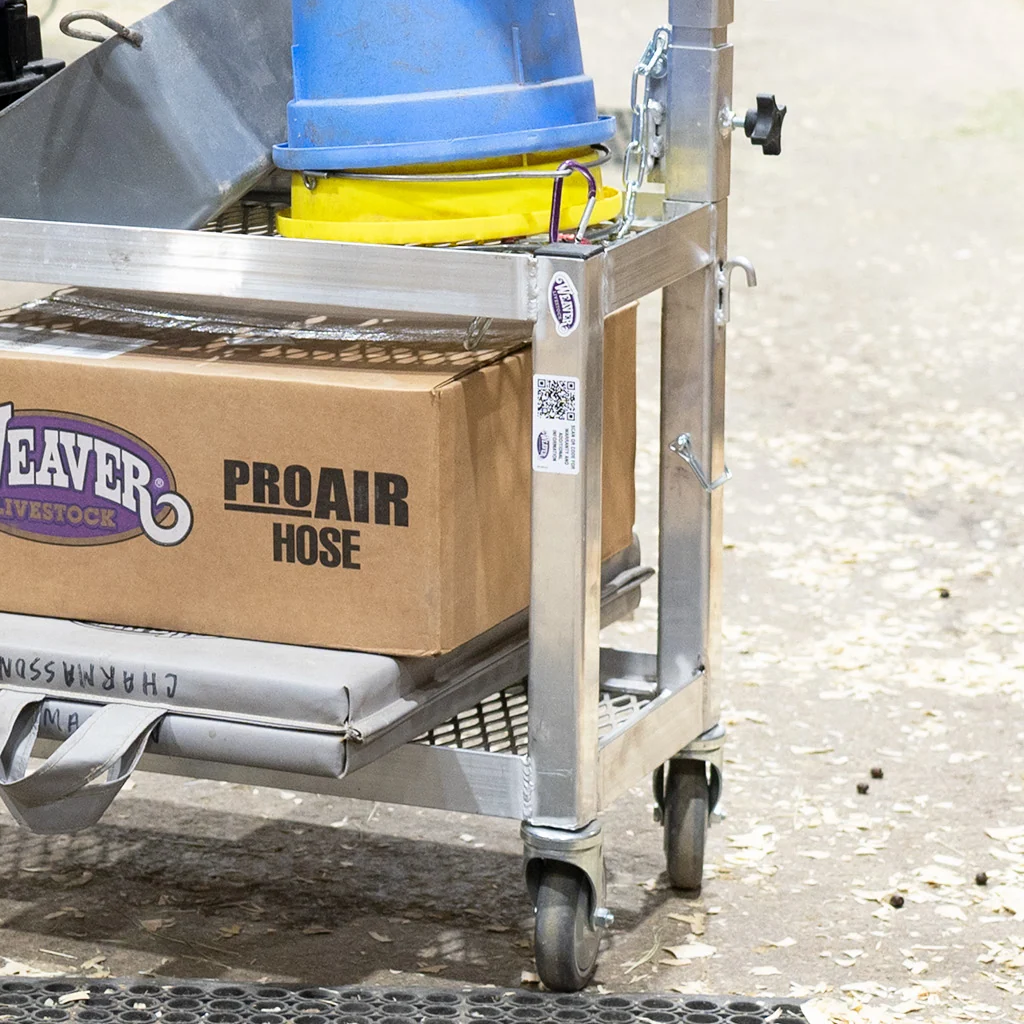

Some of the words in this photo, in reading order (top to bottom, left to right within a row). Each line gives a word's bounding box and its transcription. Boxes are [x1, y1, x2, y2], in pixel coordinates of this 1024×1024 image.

[554, 276, 575, 334] WEAVER
[223, 459, 409, 527] PROAIR
[272, 522, 361, 570] HOSE
